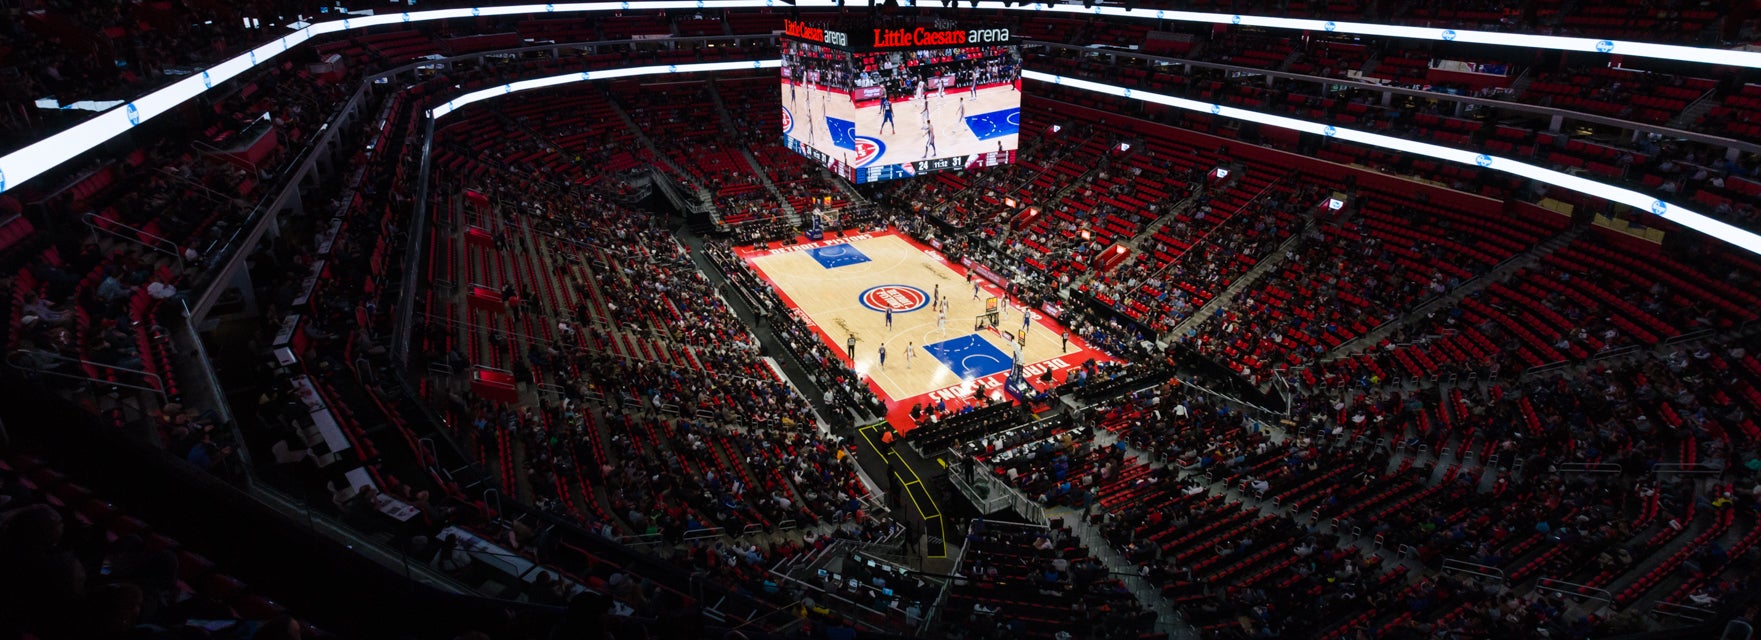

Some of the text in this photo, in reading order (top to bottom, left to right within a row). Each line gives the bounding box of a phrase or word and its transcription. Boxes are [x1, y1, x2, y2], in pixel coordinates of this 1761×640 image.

[784, 19, 846, 46] Little Caesars arena
[873, 27, 1009, 47] Little Caesars arena
[918, 161, 929, 171] 24
[952, 157, 962, 167] 31
[770, 234, 874, 254] DETROIT PISTONS
[1003, 358, 1071, 378] DETRO
